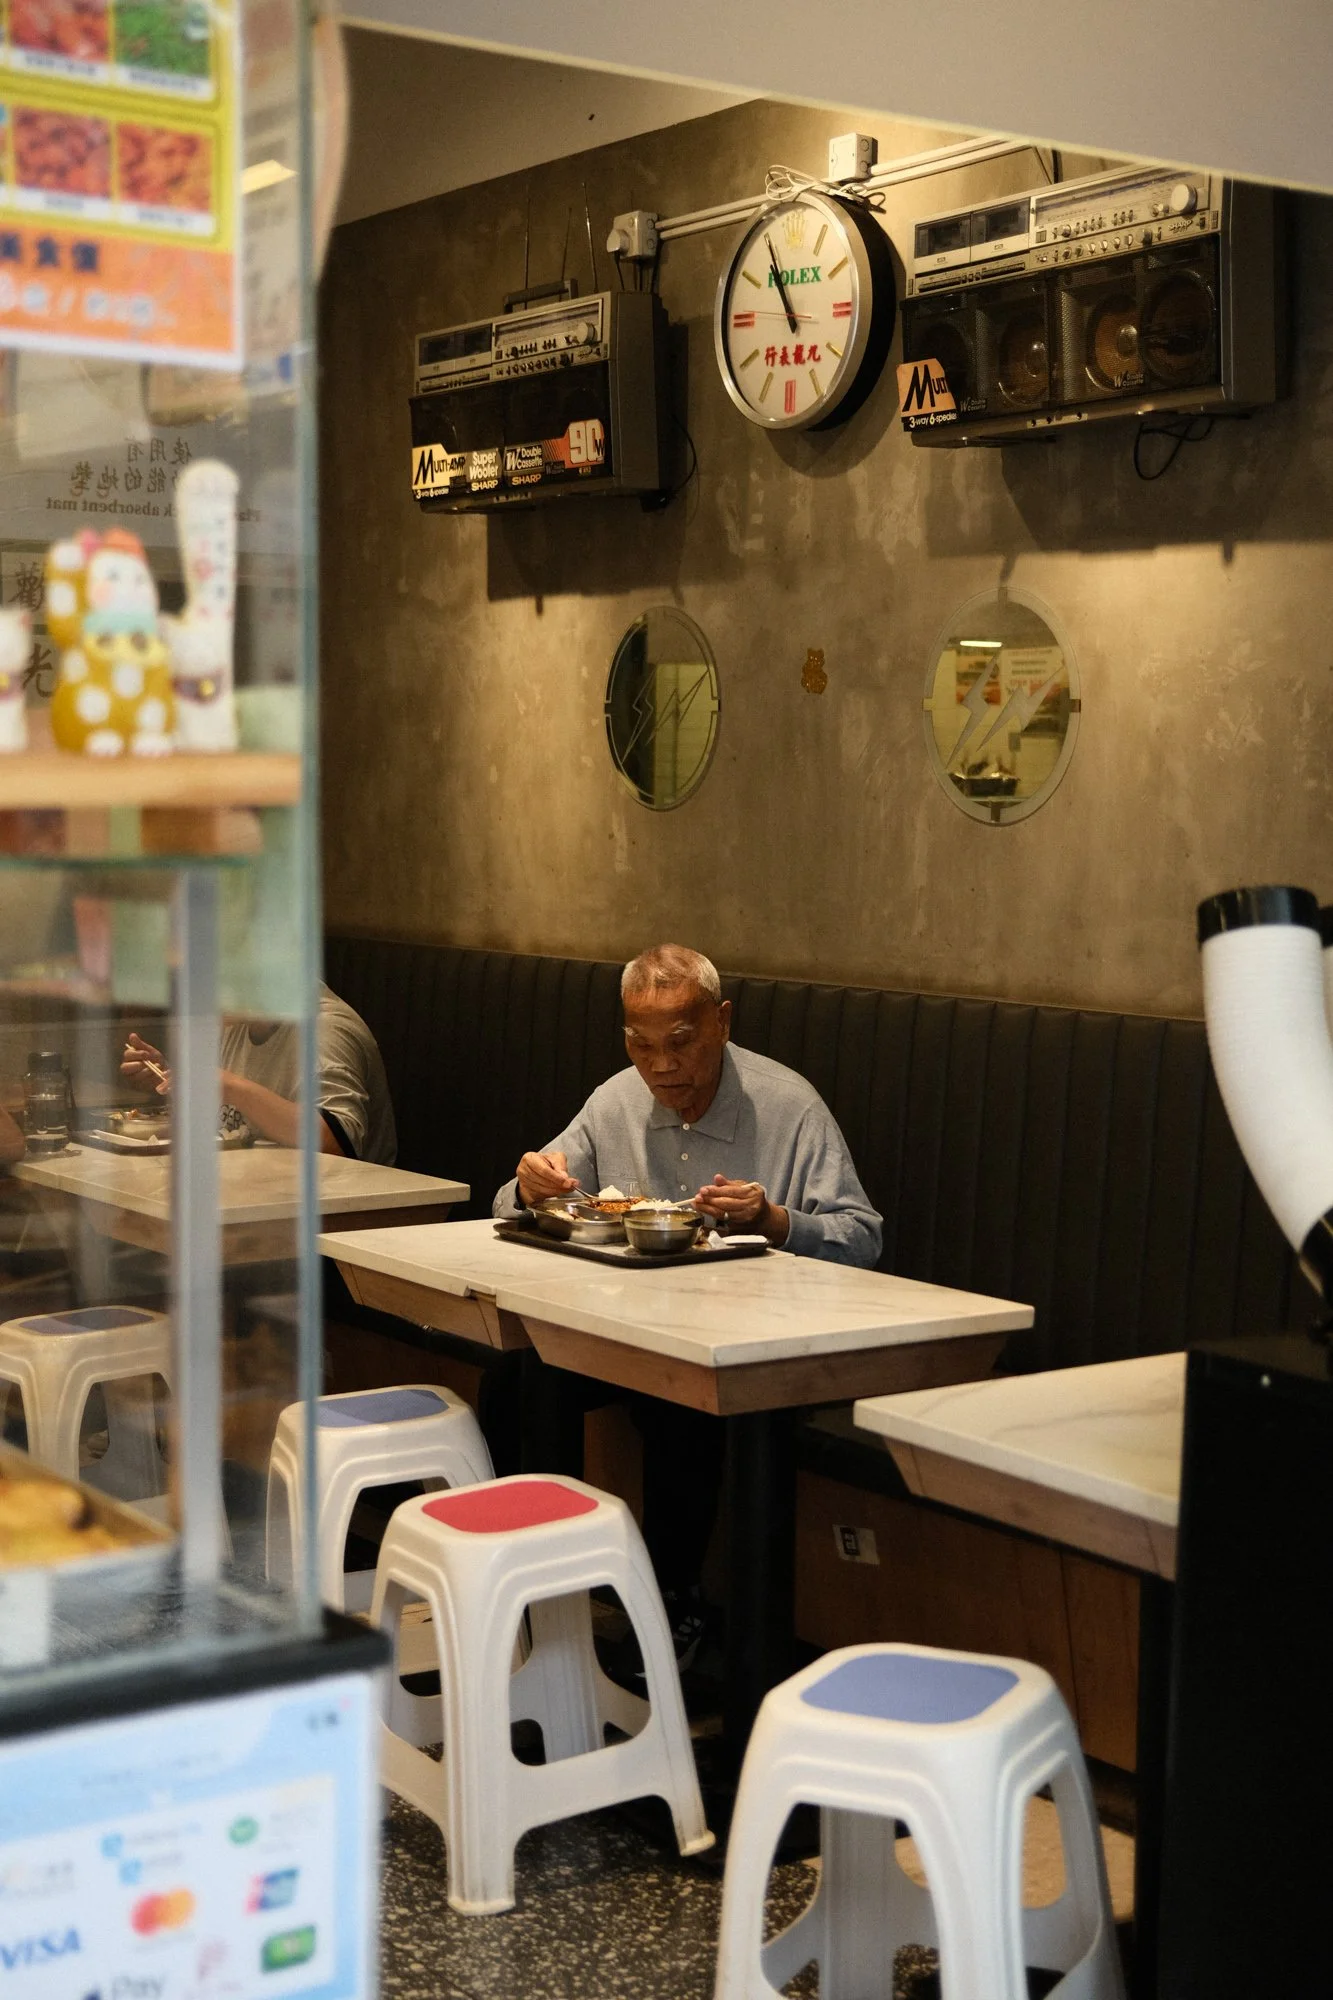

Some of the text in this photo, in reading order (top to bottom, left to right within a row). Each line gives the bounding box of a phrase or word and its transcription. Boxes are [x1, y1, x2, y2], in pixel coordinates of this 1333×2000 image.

[521, 446, 542, 458] Double
[472, 451, 497, 467] Super
[517, 456, 543, 470] Cassette
[469, 465, 499, 480] Woofer
[471, 479, 499, 492] SHARP
[511, 473, 542, 486] SHARP
